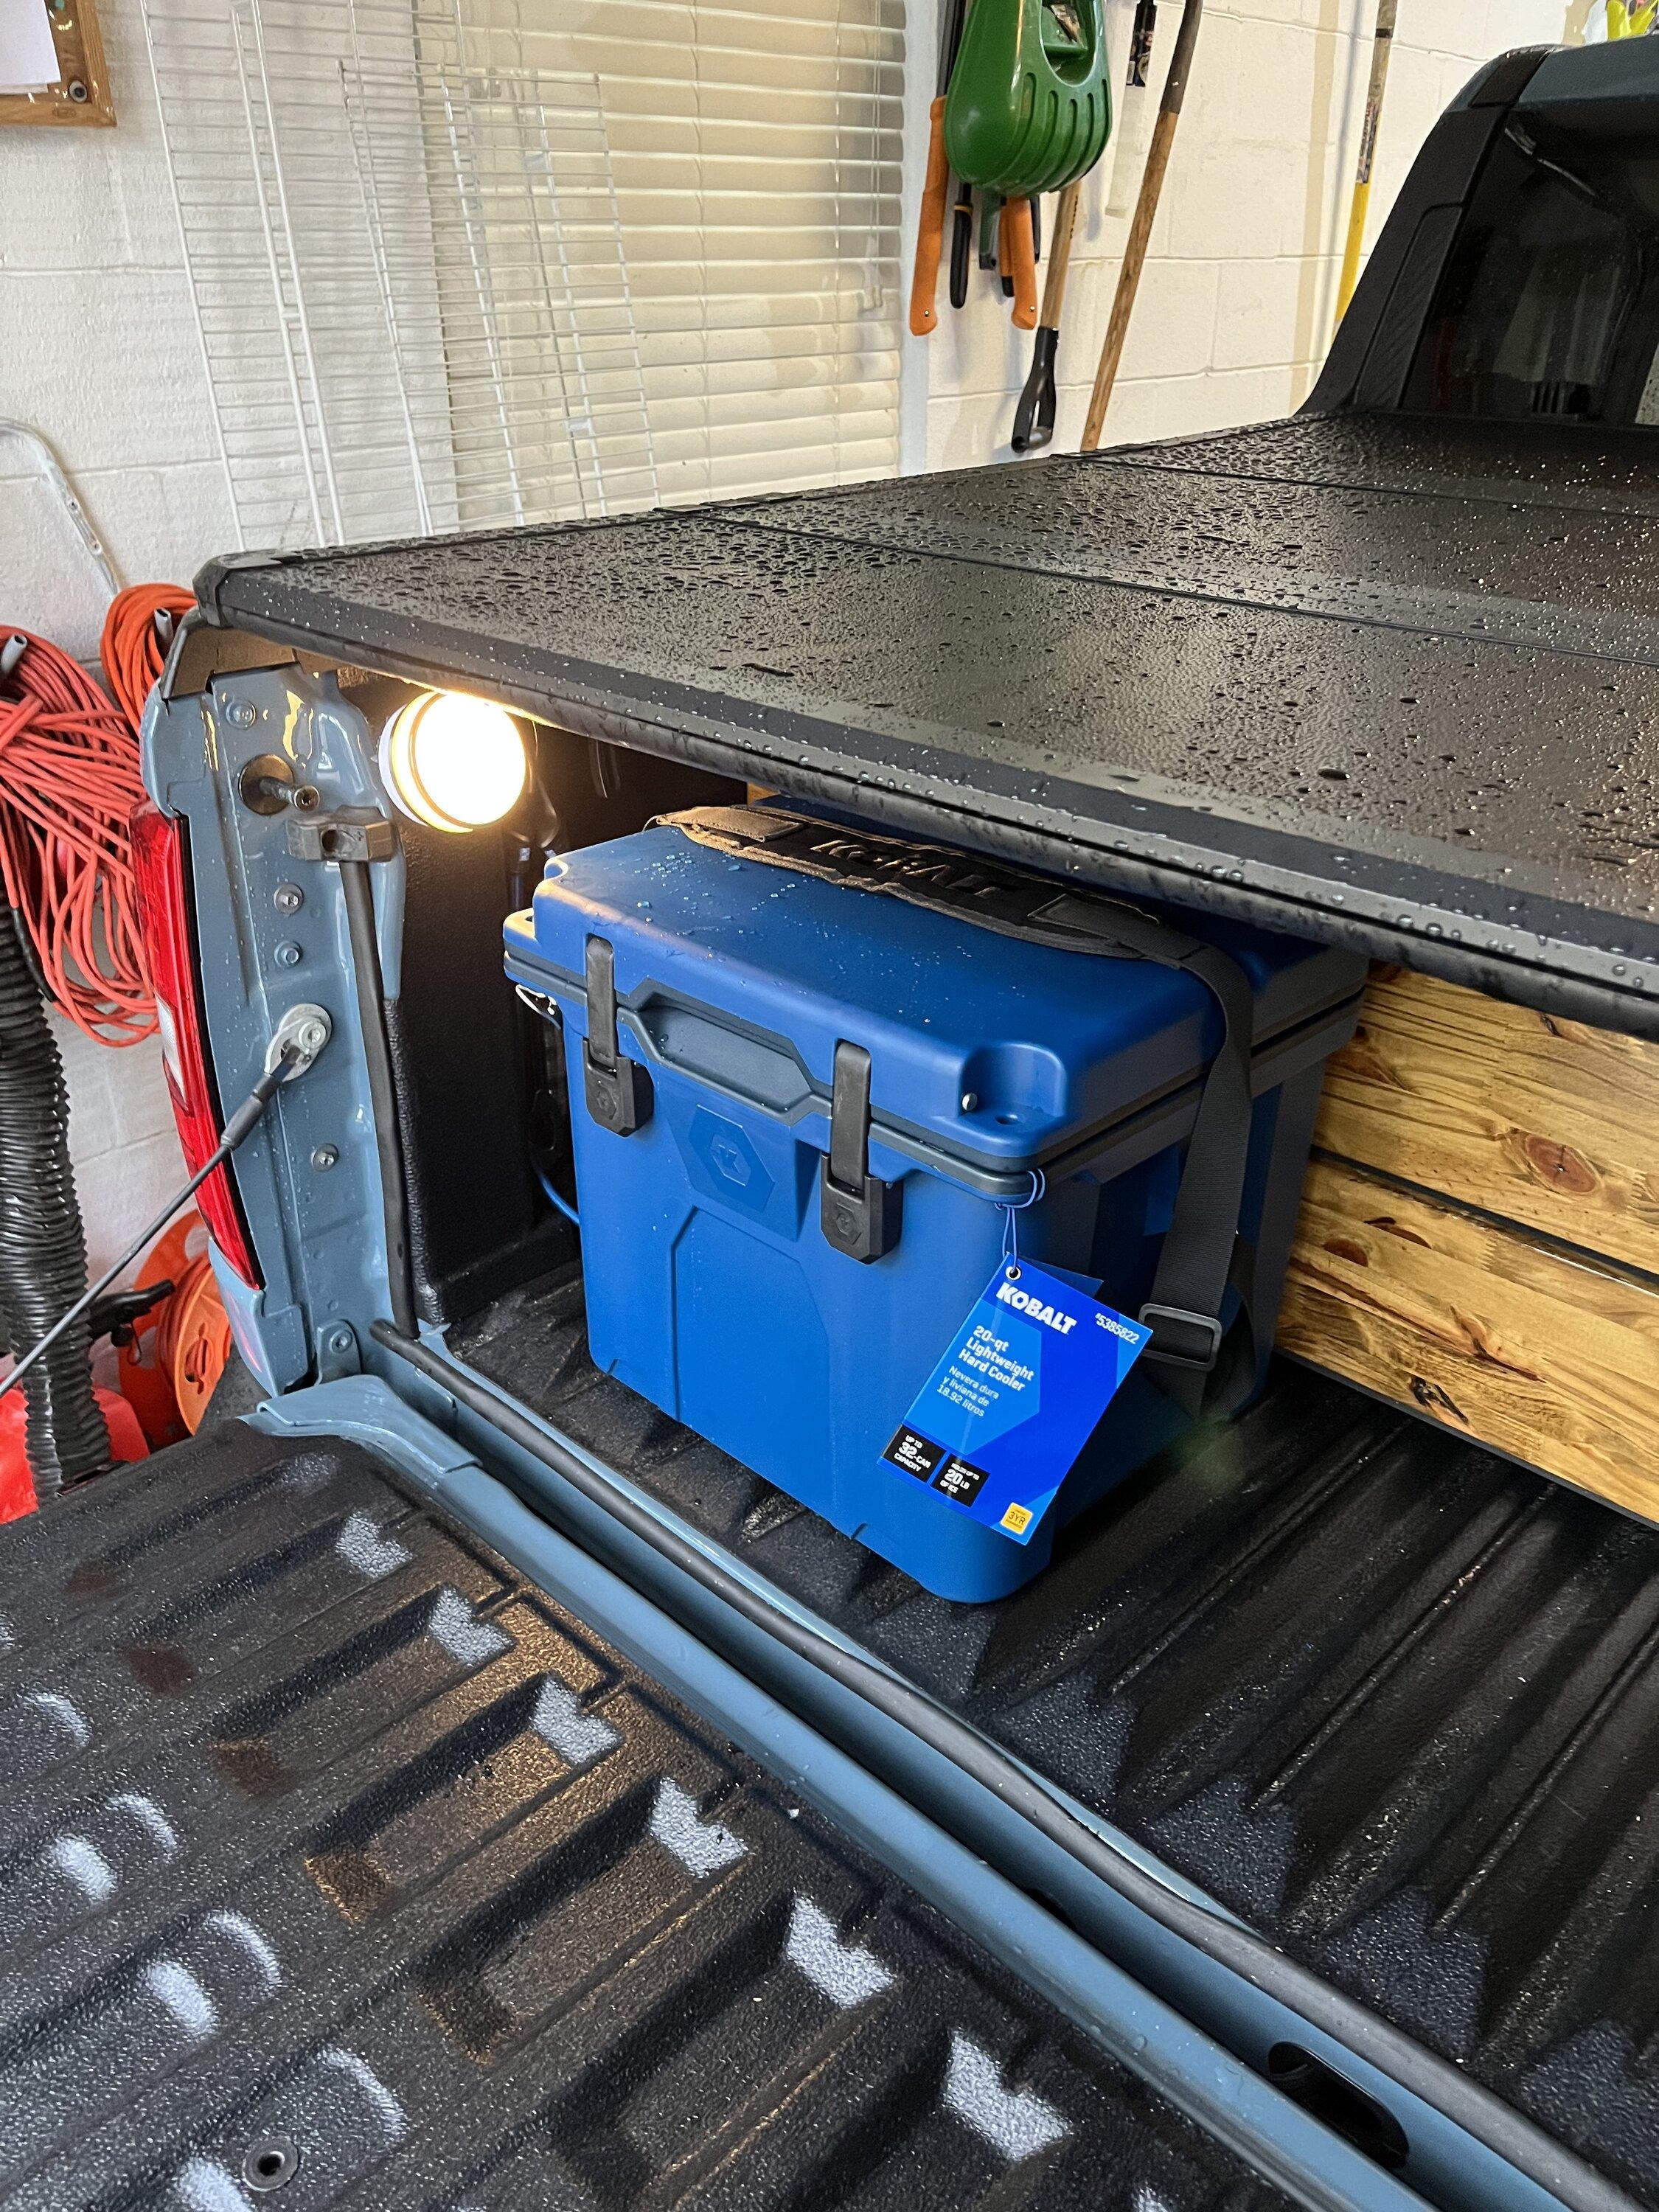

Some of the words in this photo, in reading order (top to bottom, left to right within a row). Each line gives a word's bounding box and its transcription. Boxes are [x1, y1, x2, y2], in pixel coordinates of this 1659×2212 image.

[995, 1281, 1077, 1334] KOBALT
[973, 1325, 1009, 1352] 20-qt
[959, 1348, 990, 1373] Hard
[988, 1366, 1026, 1391] Cooler
[966, 1336, 1034, 1381] Lightweight
[942, 1377, 950, 1385] y
[949, 1379, 978, 1400] liviana
[977, 1397, 990, 1406] de
[949, 1366, 979, 1388] Nevera
[978, 1385, 999, 1399] dura
[936, 1384, 963, 1404] 18.92
[962, 1399, 984, 1416] litros
[944, 1468, 964, 1485] 20
[1008, 1512, 1026, 1525] 3YR
